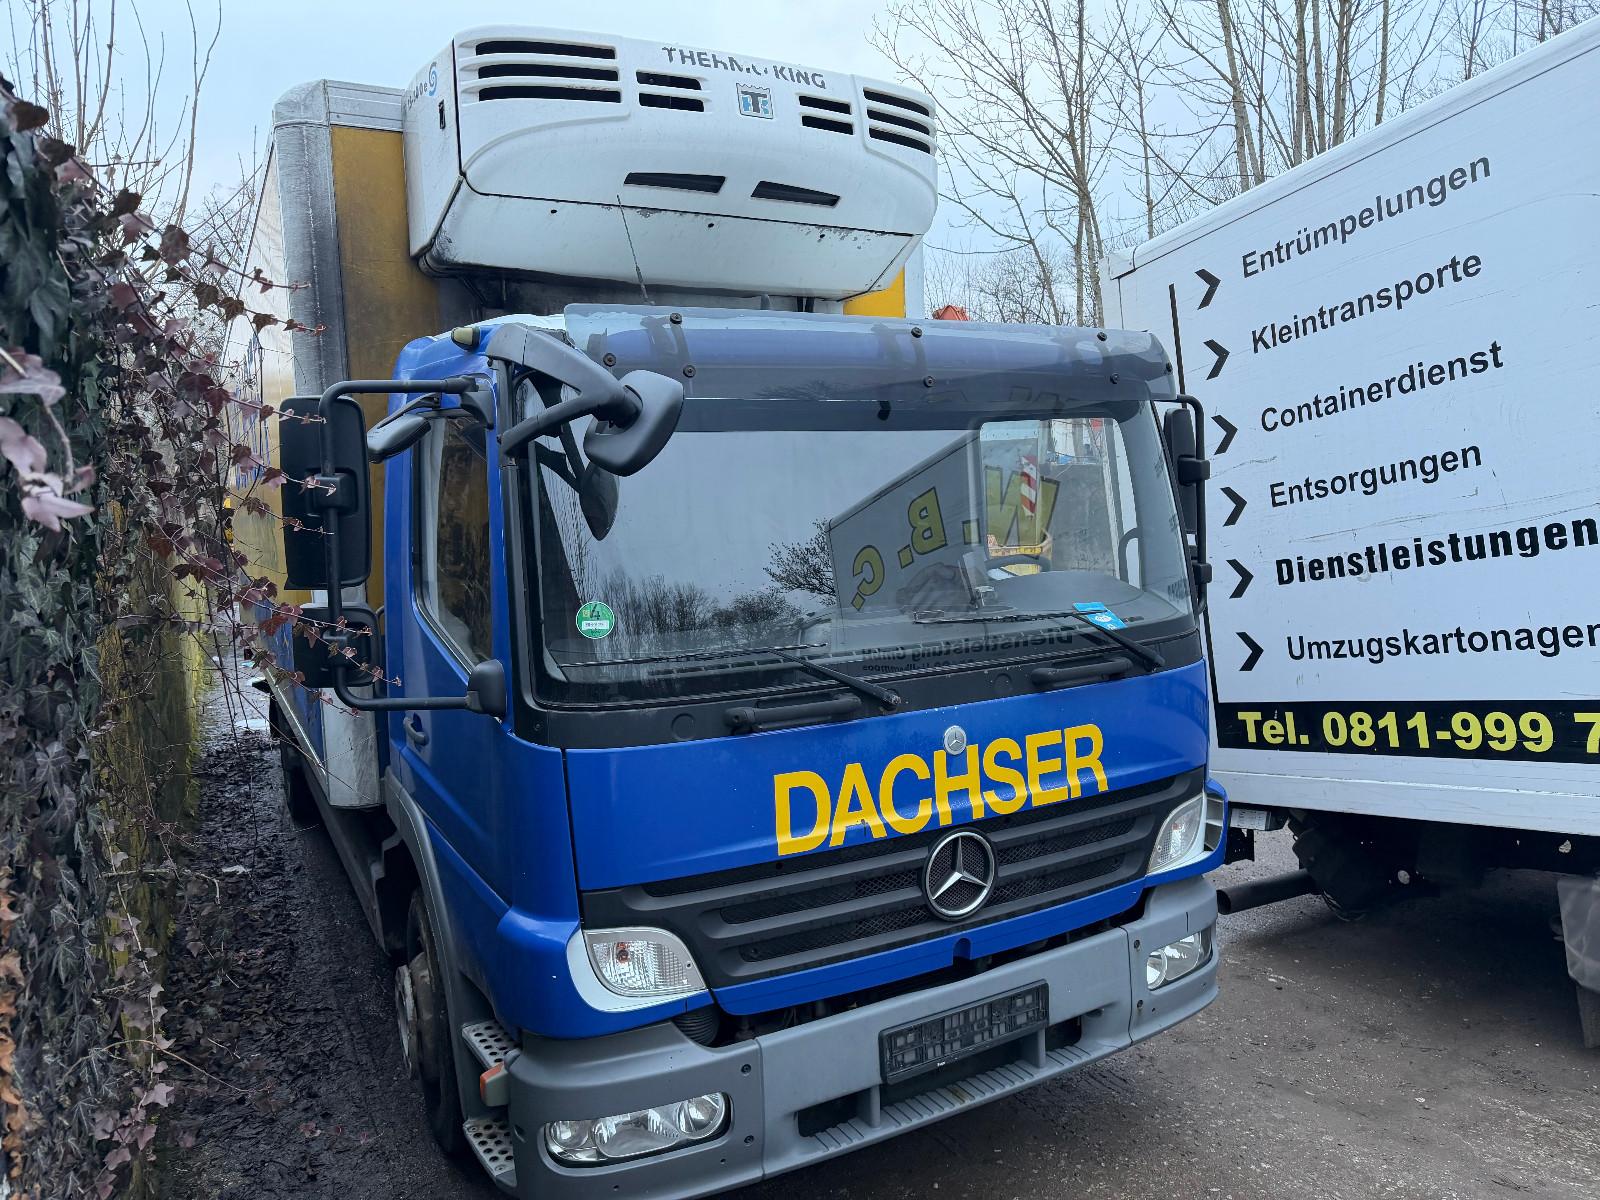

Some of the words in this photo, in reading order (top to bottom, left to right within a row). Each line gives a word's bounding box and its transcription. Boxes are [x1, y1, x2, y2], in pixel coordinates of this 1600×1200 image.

[772, 63, 826, 90] KING
[1242, 156, 1491, 279] Entrümpelungen
[1251, 253, 1483, 354] Kleintransporte
[1260, 340, 1504, 432] Containerdienst
[1269, 444, 1482, 508] Entsorgungen
[1275, 517, 1599, 586] Dienstleistungen
[1238, 711, 1310, 745] Tel.
[1322, 711, 1554, 753] 0811-999
[773, 723, 1109, 856] DACHSER
